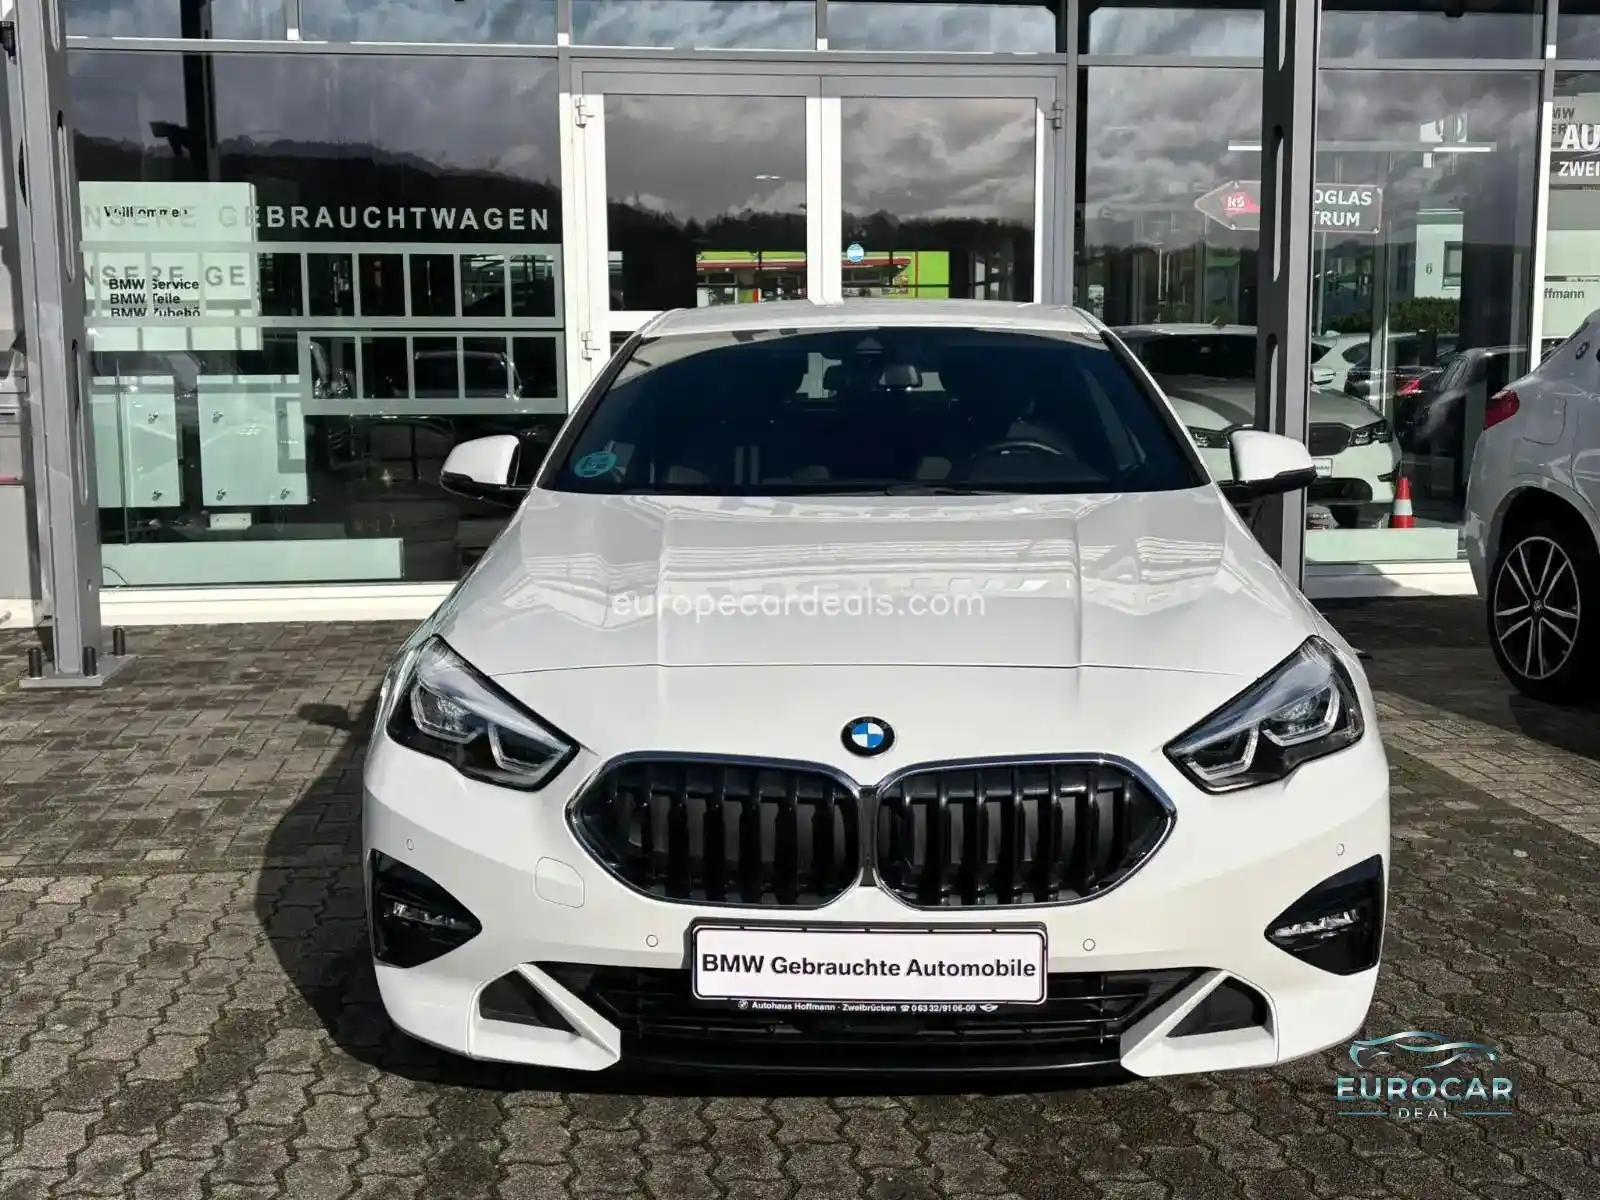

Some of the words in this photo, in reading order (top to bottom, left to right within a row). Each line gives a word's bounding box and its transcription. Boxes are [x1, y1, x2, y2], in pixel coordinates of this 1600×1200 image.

[1558, 161, 1600, 177] ZWEI
[219, 205, 549, 231] GEBRAUCHTWAGEN
[109, 278, 145, 290] BMW
[151, 278, 199, 290] Service
[110, 293, 146, 305] BMW
[111, 307, 147, 317] BMW
[702, 953, 765, 973] BMW
[770, 955, 901, 977] Gebrauchte
[906, 958, 1037, 977] Automobile
[751, 1001, 793, 1010] Autohaus
[794, 1002, 836, 1011] Hoffmann
